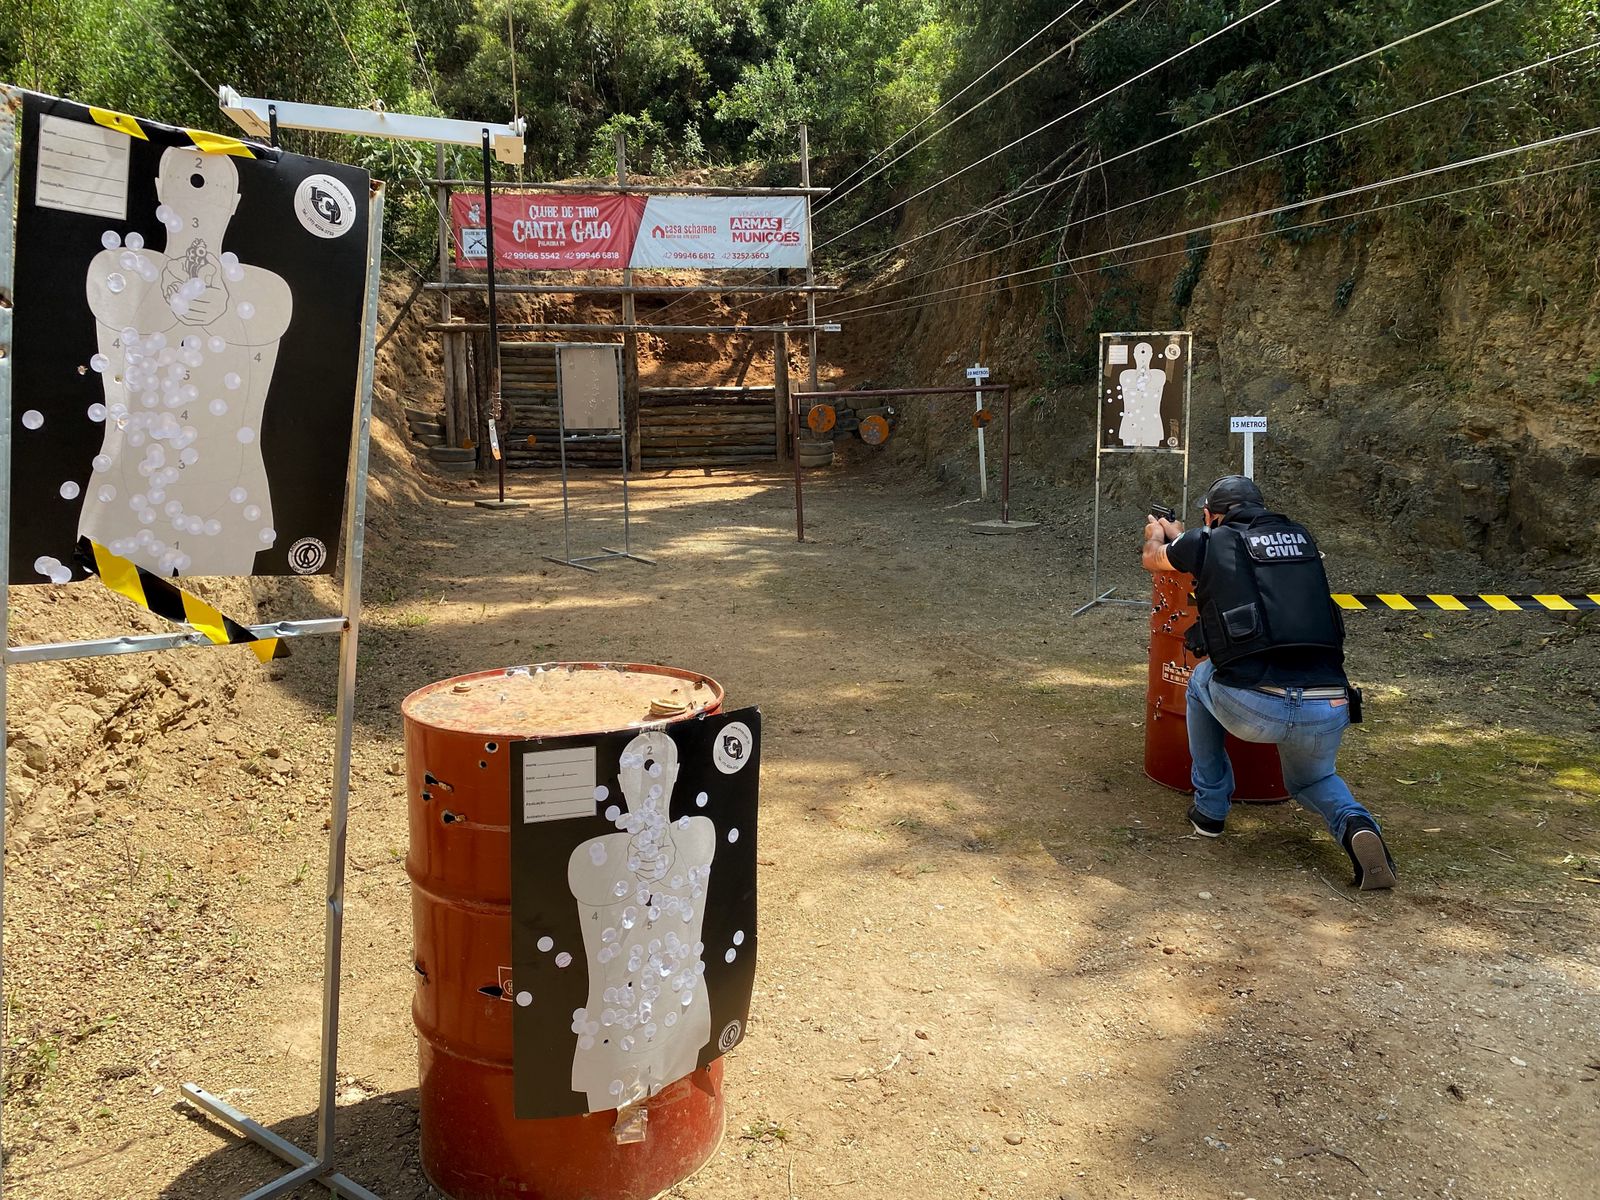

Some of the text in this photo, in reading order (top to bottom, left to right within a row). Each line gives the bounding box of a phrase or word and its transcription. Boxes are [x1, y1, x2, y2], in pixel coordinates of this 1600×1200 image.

[195, 158, 202, 168] 2
[529, 205, 599, 220] CLUBE DE TIRO
[192, 217, 199, 228] 3
[732, 218, 778, 230] ARMAS
[512, 219, 610, 242] CANTA GALO
[665, 225, 682, 234] casa
[112, 338, 120, 348] 4
[254, 352, 262, 362] 4
[181, 410, 188, 420] 4
[1250, 532, 1308, 546] POLÍCIA
[1266, 545, 1303, 558] CIVIL
[647, 746, 653, 755] 2
[592, 912, 598, 920] 4
